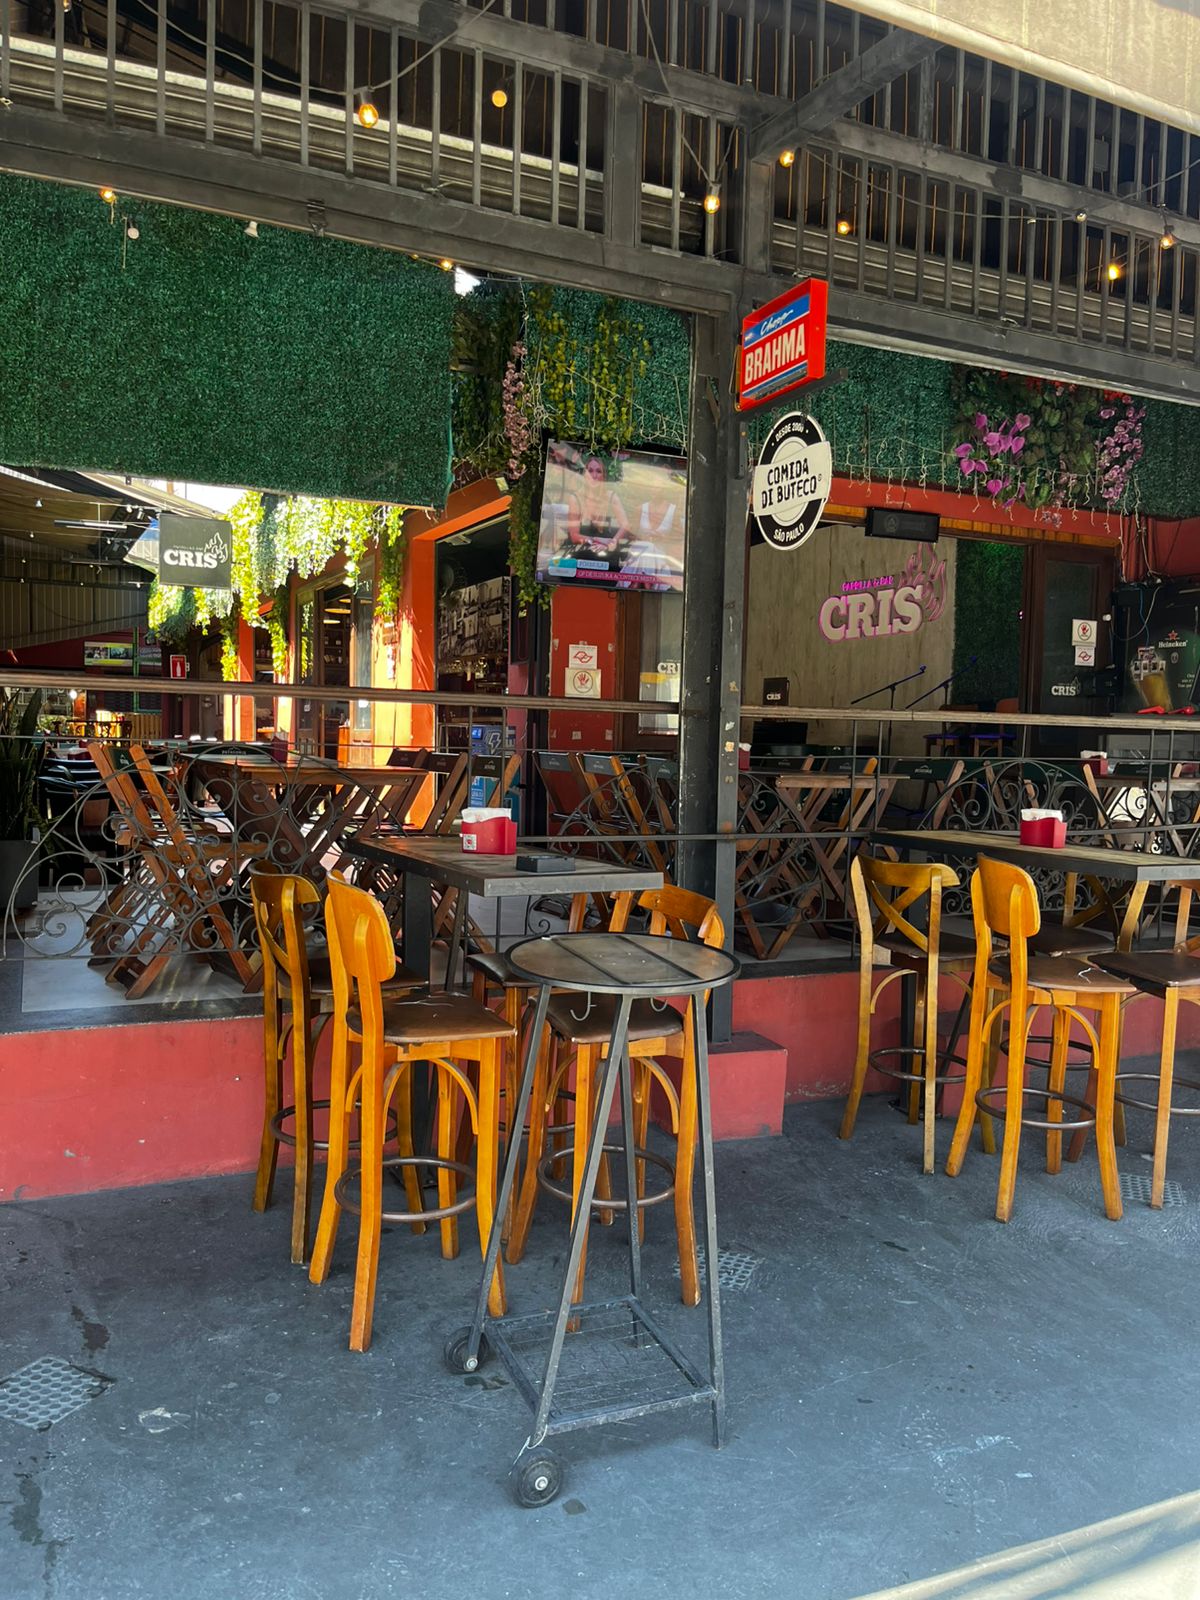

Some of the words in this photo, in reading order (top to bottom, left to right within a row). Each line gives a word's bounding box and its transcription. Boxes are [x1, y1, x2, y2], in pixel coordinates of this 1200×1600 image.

[744, 323, 806, 385] BRAHMA
[775, 423, 791, 442] DESDE
[767, 457, 809, 486] COMIDA
[761, 488, 773, 509] DI
[777, 475, 817, 504] BUTECO
[773, 528, 785, 542] SÃO
[786, 522, 805, 542] PAULO
[163, 548, 218, 569] CRIS
[819, 585, 922, 642] CRIS
[657, 662, 680, 674] CRI
[1051, 685, 1076, 696] CRIS
